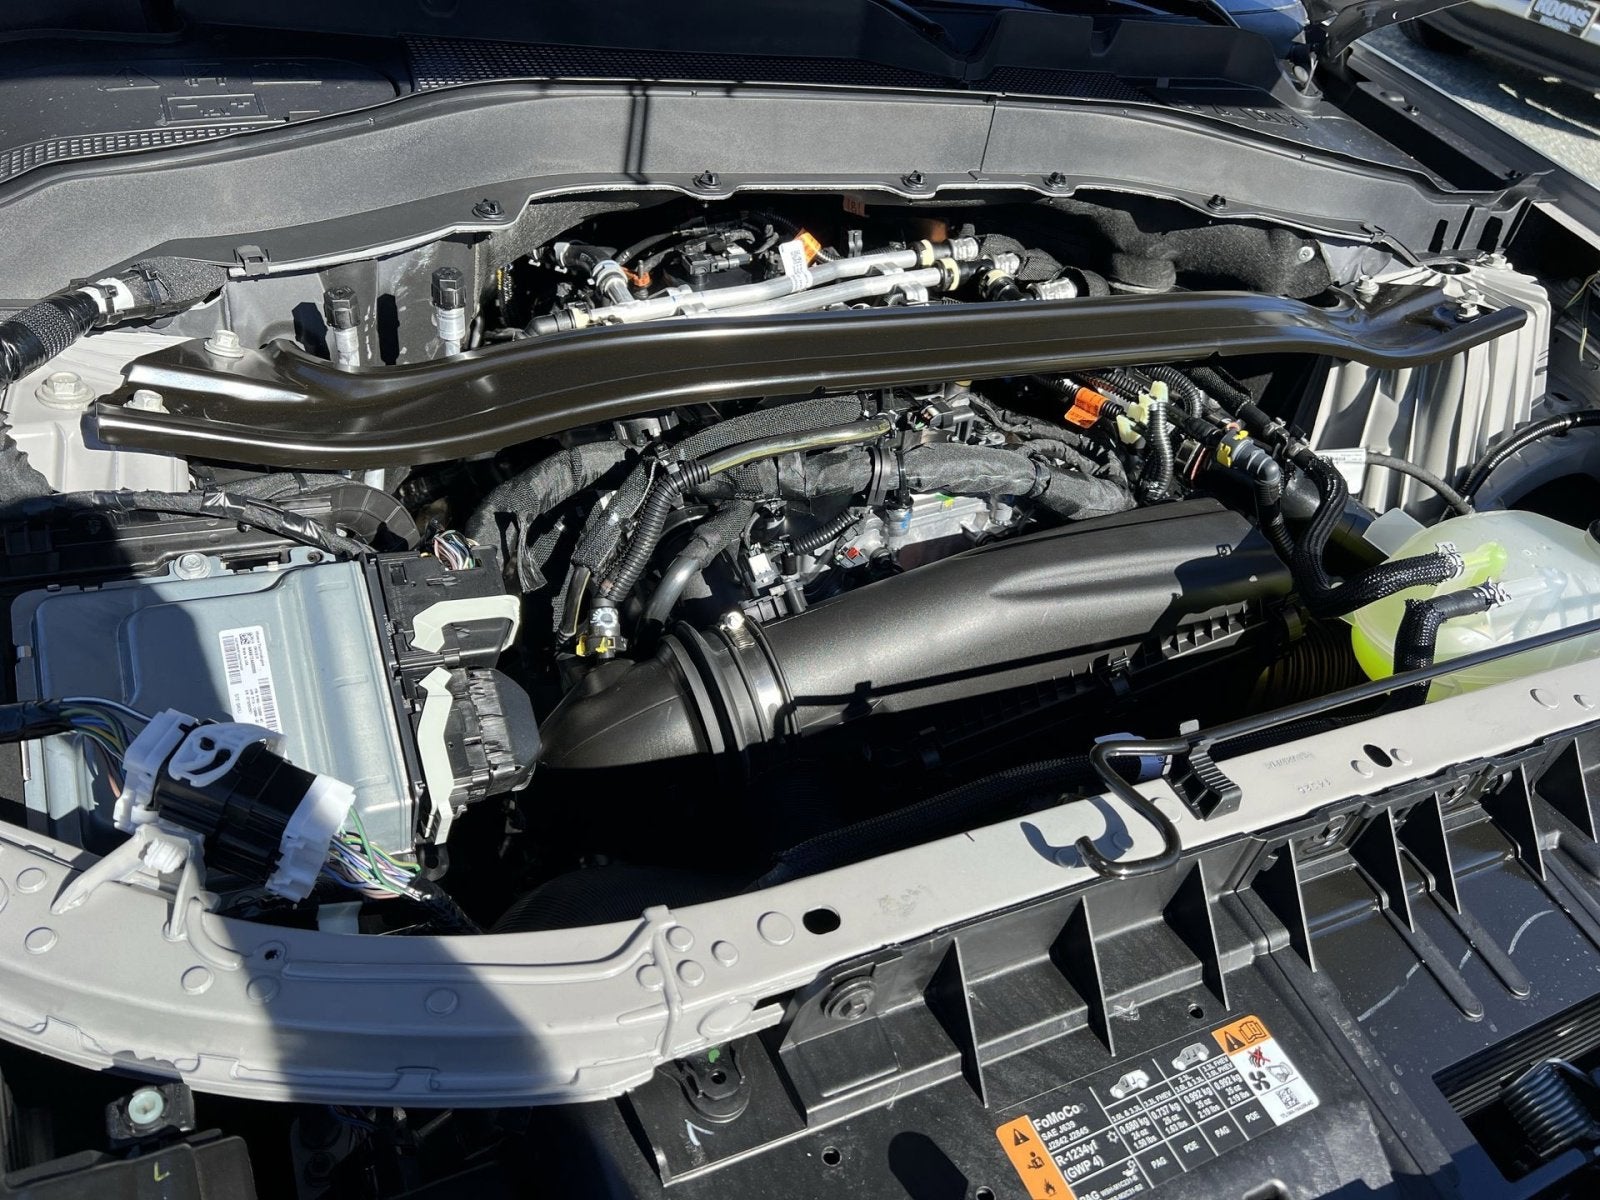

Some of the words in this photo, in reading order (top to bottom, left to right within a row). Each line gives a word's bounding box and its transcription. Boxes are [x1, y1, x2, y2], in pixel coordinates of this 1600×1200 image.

[1230, 1073, 1243, 1083] kg
[1200, 1087, 1213, 1096] kg
[1032, 1104, 1081, 1131] FoMoCo
[1150, 1105, 1170, 1120] 0.737
[1168, 1102, 1181, 1112] kg
[1244, 1111, 1261, 1123] POE
[1137, 1116, 1150, 1127] kg
[1041, 1127, 1059, 1141] SAE
[1140, 1128, 1149, 1136] oz
[1214, 1125, 1231, 1138] PAG
[1055, 1139, 1098, 1167] R-1234yf
[1183, 1140, 1200, 1154] POE
[1063, 1159, 1091, 1182] (GWP
[1092, 1154, 1105, 1168] 4)
[1150, 1156, 1168, 1169] PAG
